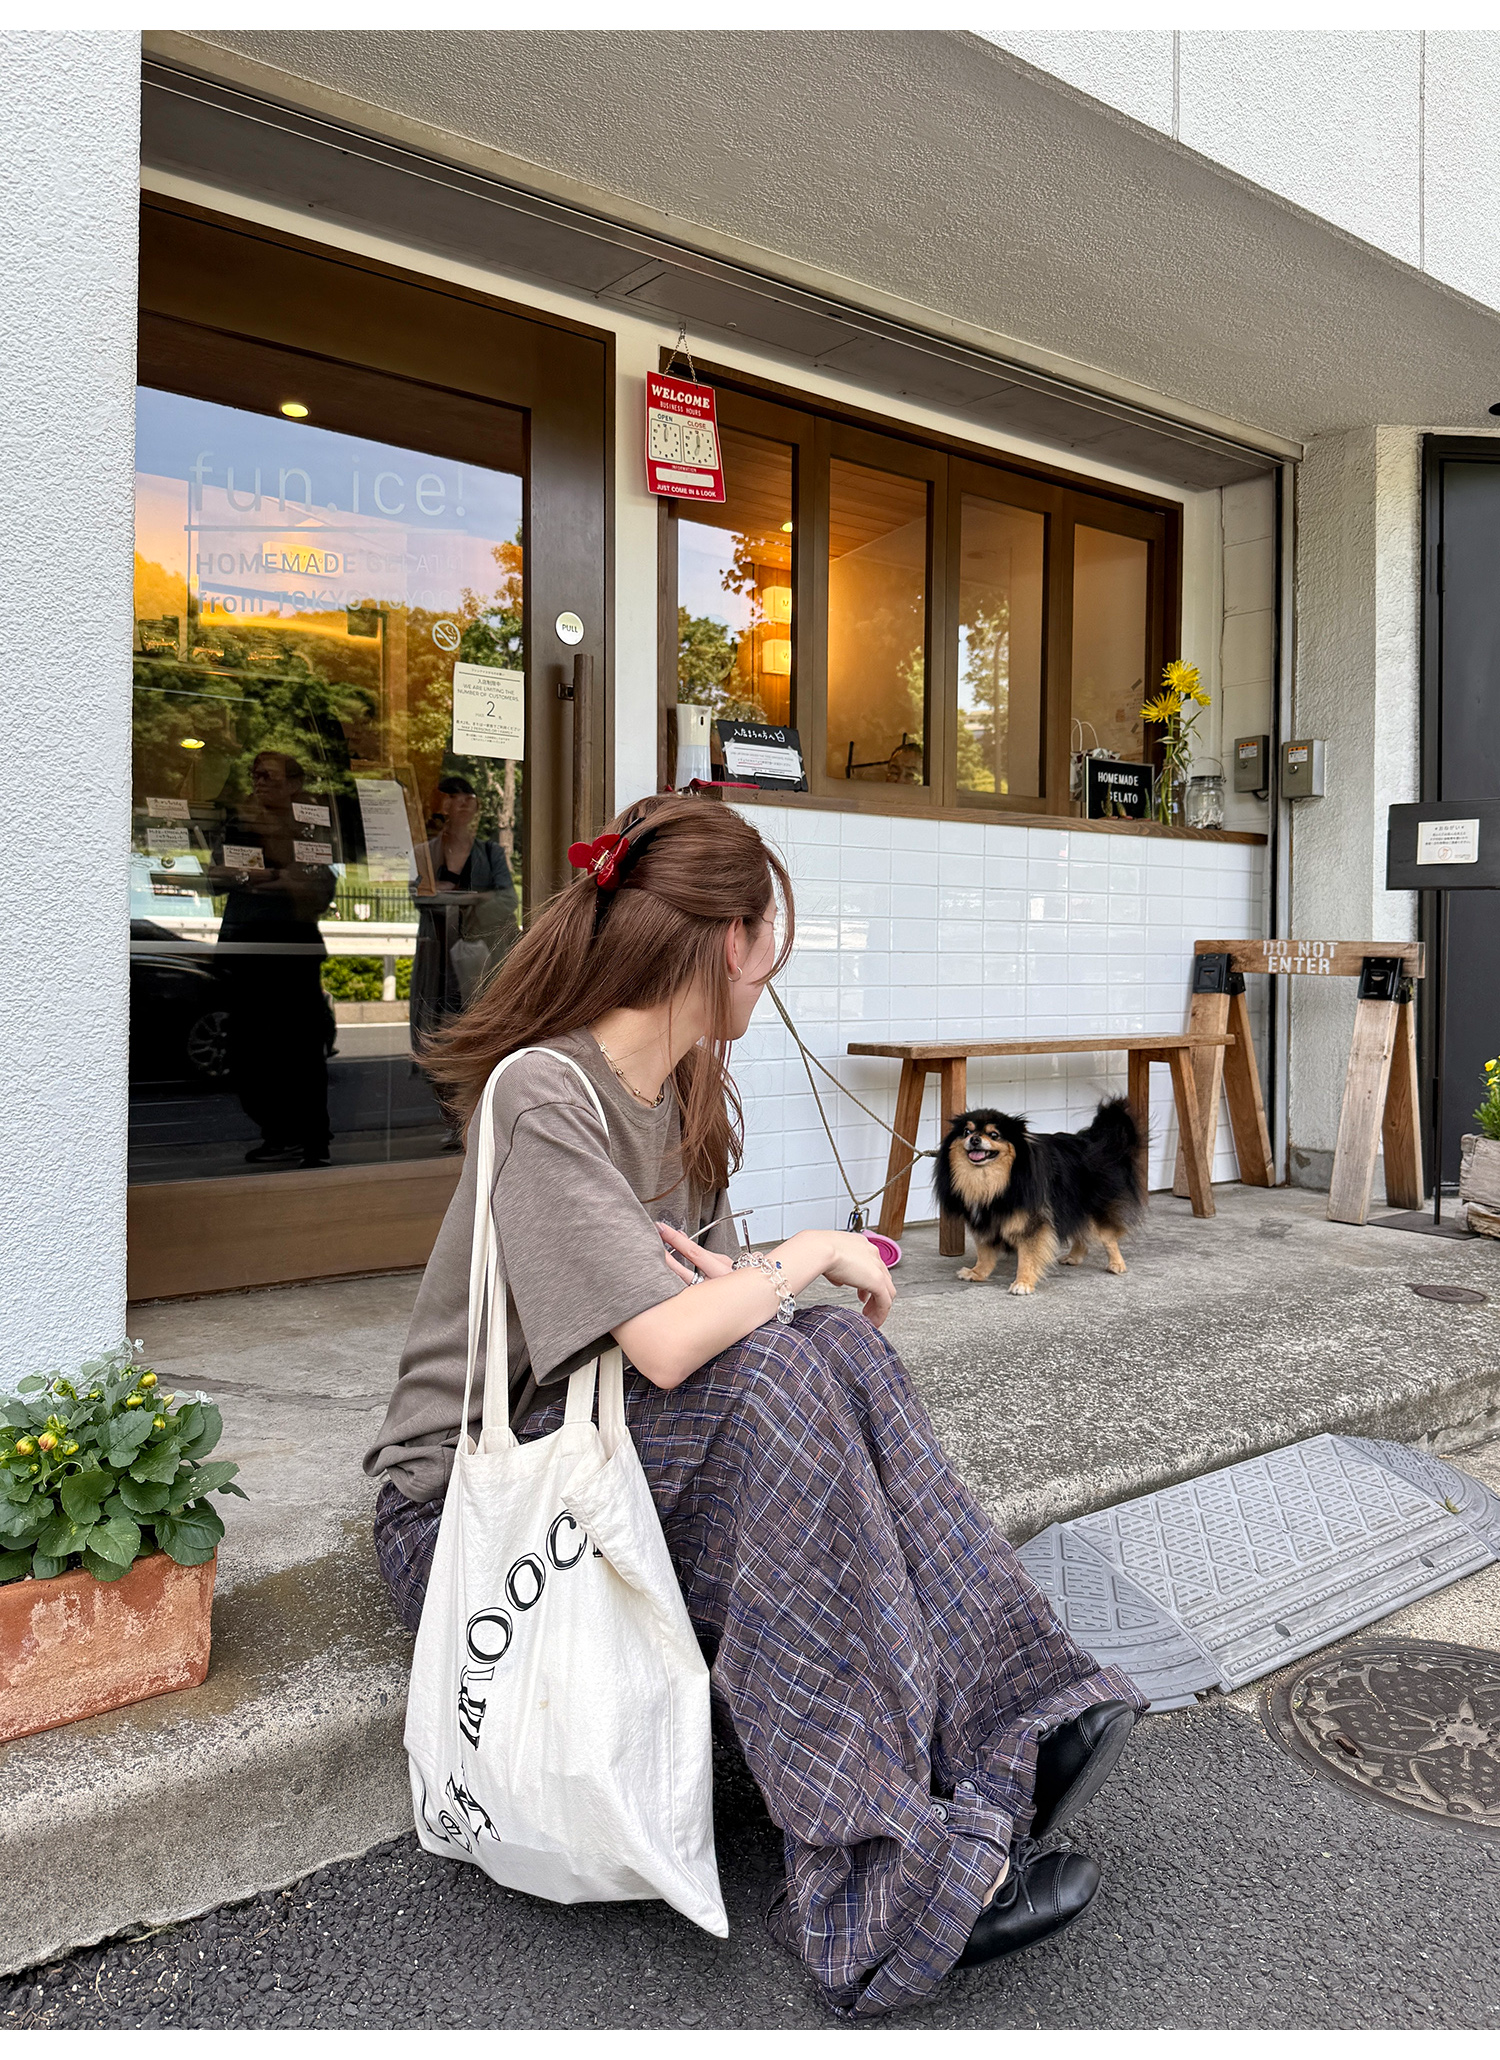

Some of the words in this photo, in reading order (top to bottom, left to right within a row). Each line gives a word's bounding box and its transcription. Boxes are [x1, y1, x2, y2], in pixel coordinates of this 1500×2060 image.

[651, 384, 710, 409] WELCOME
[660, 400, 684, 413] BUSINESS
[686, 407, 702, 417] HOURS
[657, 413, 673, 422] OPEN
[687, 420, 707, 430] CLOSE
[189, 451, 466, 517] fun.ice!
[657, 483, 670, 492] JUST
[671, 485, 688, 495] COME
[700, 490, 717, 498] LOOK
[196, 552, 356, 575] HOMEMADE
[199, 591, 264, 614] from
[273, 589, 363, 611] TOKYO
[562, 624, 578, 633] PULL
[457, 688, 480, 696] NUMBER
[483, 686, 505, 694] LIMITING
[486, 701, 496, 717] 2
[1097, 771, 1139, 787] HOMEMADE
[1262, 940, 1288, 956] DO
[1298, 941, 1339, 958] NOT
[1268, 956, 1331, 975] ENTER
